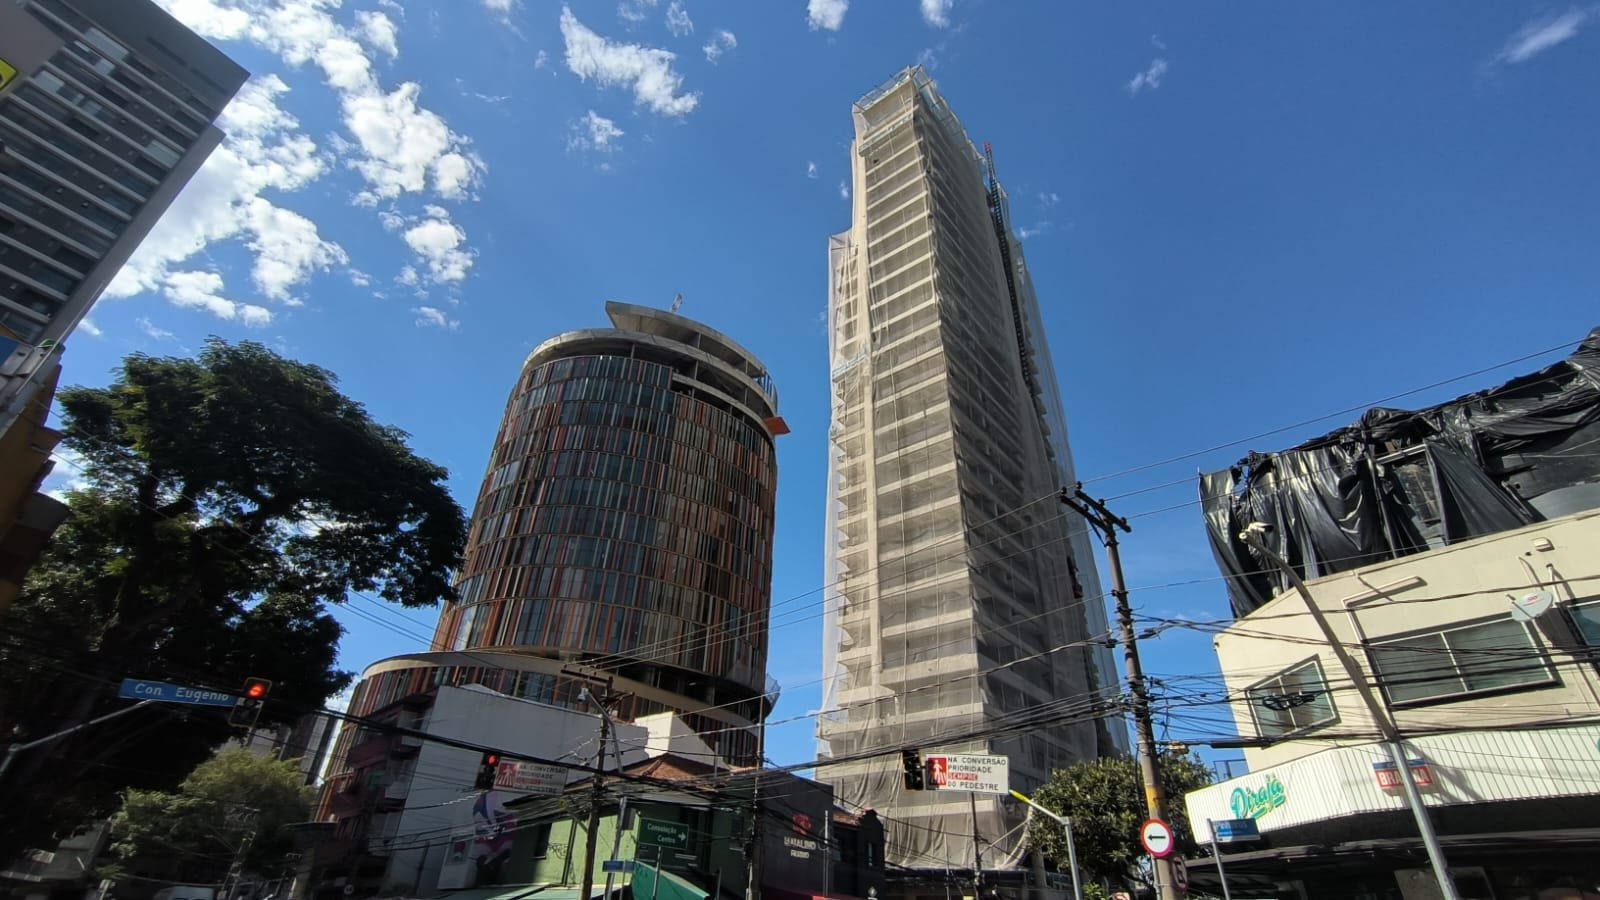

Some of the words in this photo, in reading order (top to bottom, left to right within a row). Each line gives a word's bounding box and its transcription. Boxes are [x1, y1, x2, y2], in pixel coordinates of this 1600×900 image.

[962, 756, 1007, 767] CONVERSÃO
[947, 764, 993, 774] PRIORIDADE
[960, 782, 999, 791] PEDESTRE
